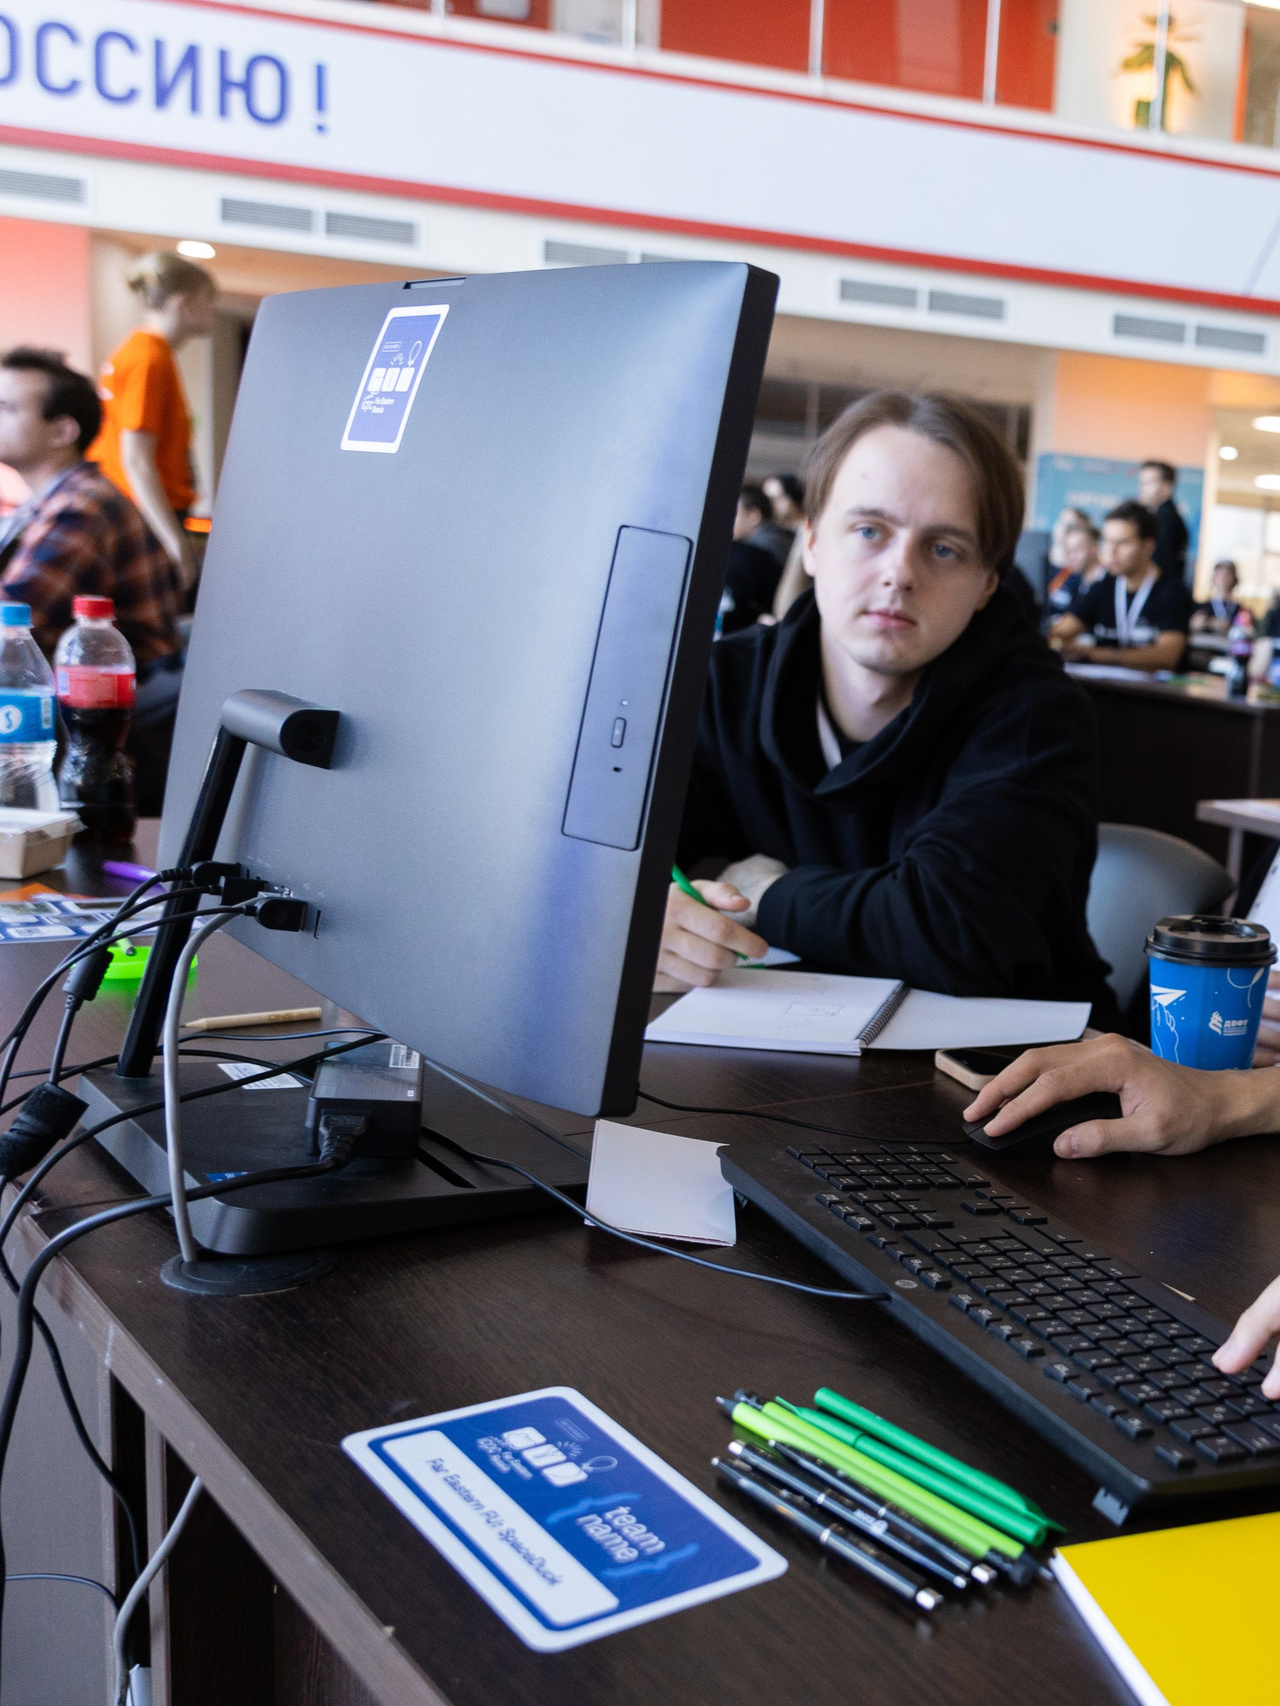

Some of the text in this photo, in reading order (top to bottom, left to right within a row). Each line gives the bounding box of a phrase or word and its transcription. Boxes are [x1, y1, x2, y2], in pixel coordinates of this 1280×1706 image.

[427, 1457, 449, 1473] Far
[442, 1473, 485, 1511] Eastern
[498, 1527, 564, 1586] SpaceDuck
[576, 1513, 639, 1564] name
[604, 1505, 667, 1556] team
